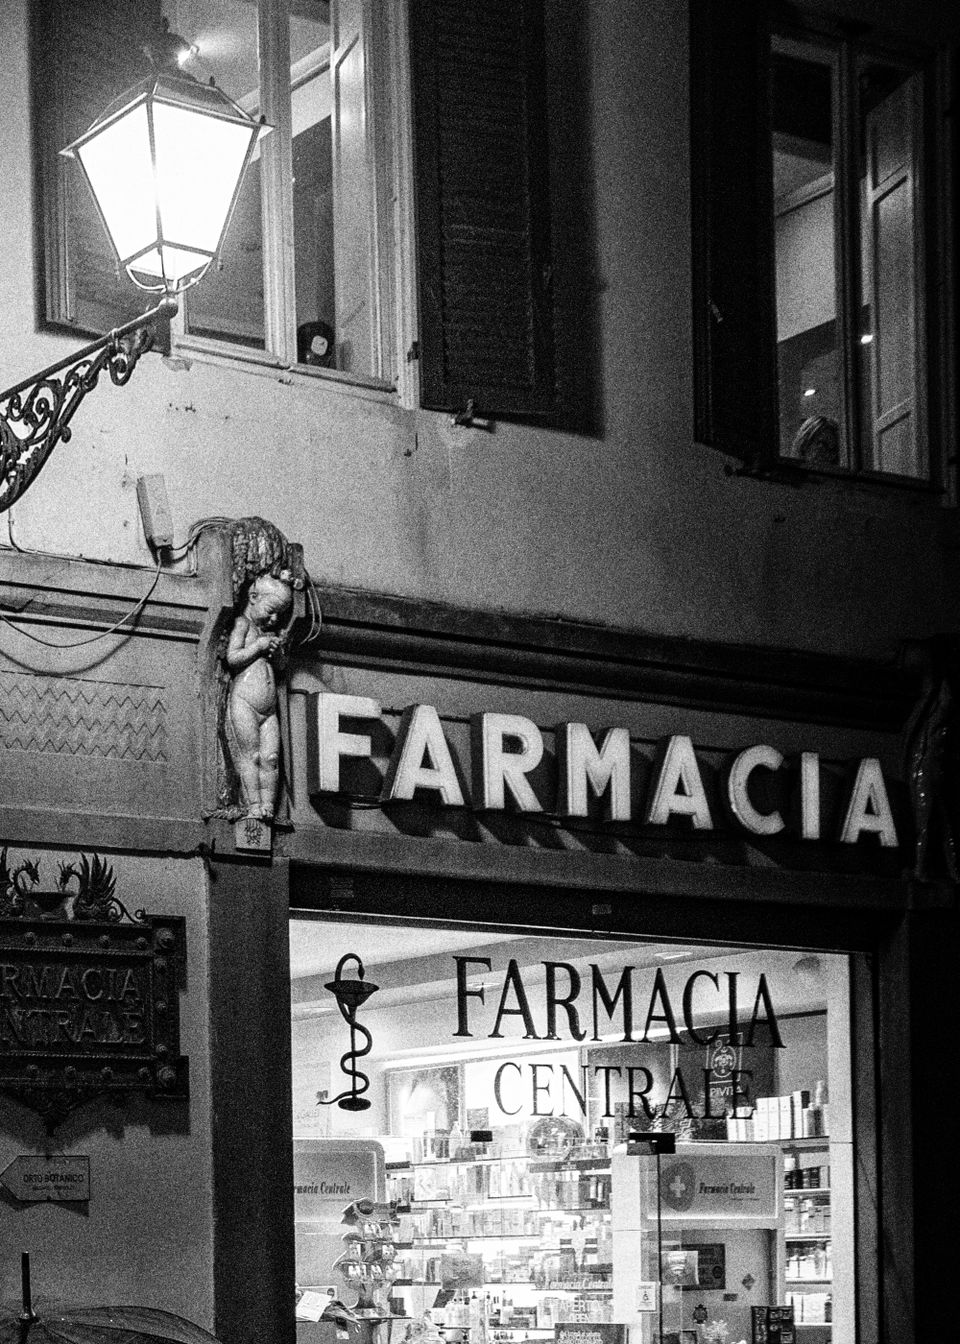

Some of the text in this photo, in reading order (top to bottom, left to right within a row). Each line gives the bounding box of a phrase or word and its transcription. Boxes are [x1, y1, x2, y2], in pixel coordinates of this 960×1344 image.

[314, 692, 899, 848] FARMACIA
[452, 956, 787, 1049] FARMACIA
[493, 1061, 755, 1120] CENTRALE
